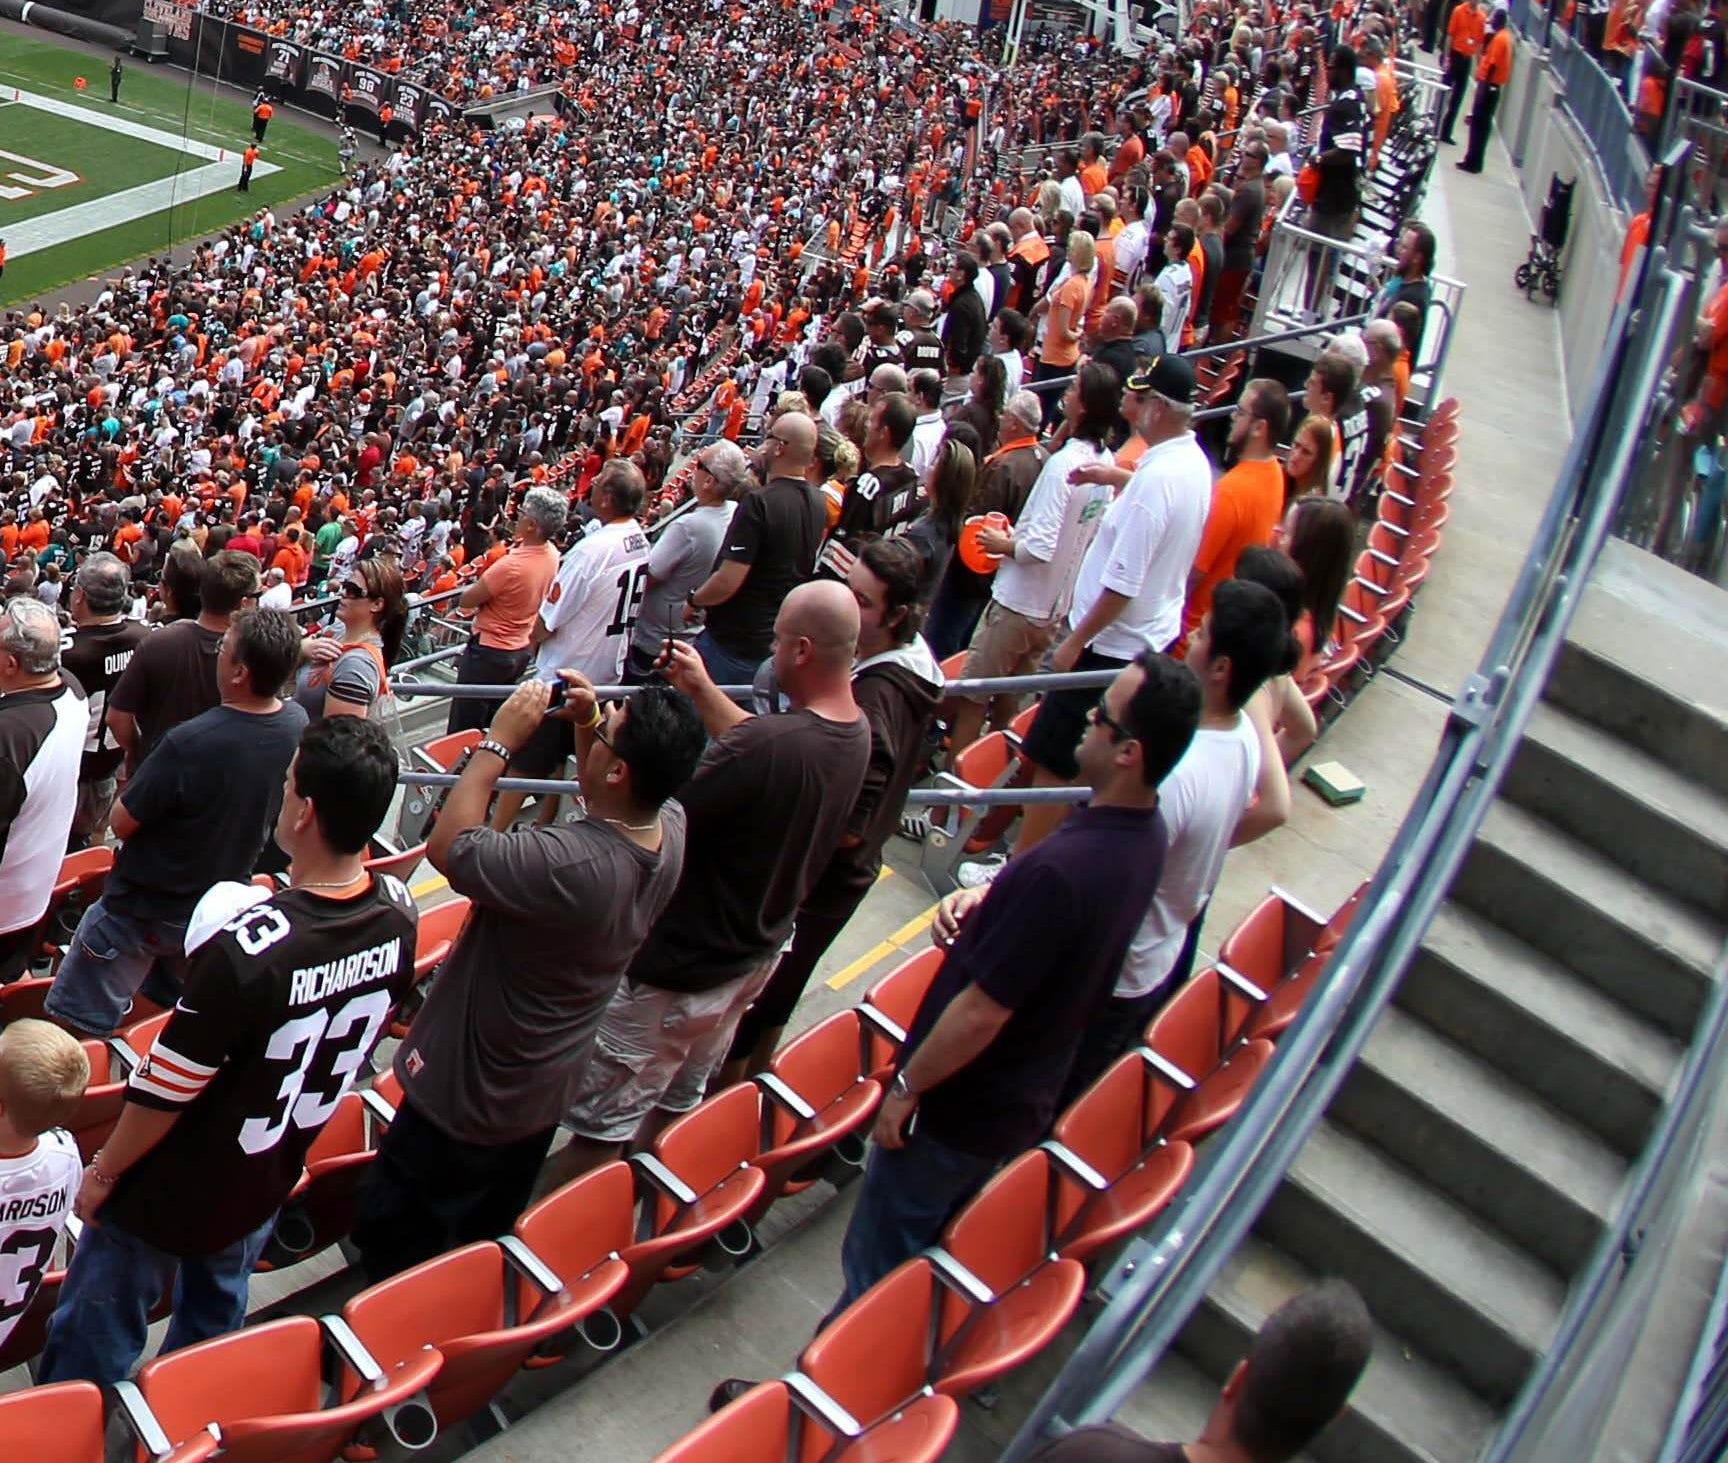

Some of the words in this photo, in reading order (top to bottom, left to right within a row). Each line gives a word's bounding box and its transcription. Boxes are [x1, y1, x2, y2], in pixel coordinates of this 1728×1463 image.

[277, 49, 290, 64] 71
[358, 78, 375, 93] 98
[399, 93, 414, 108] 23
[104, 649, 135, 676] QUIN
[227, 903, 291, 957] 33
[288, 935, 402, 1008] RICHARDSON
[237, 987, 394, 1155] 33
